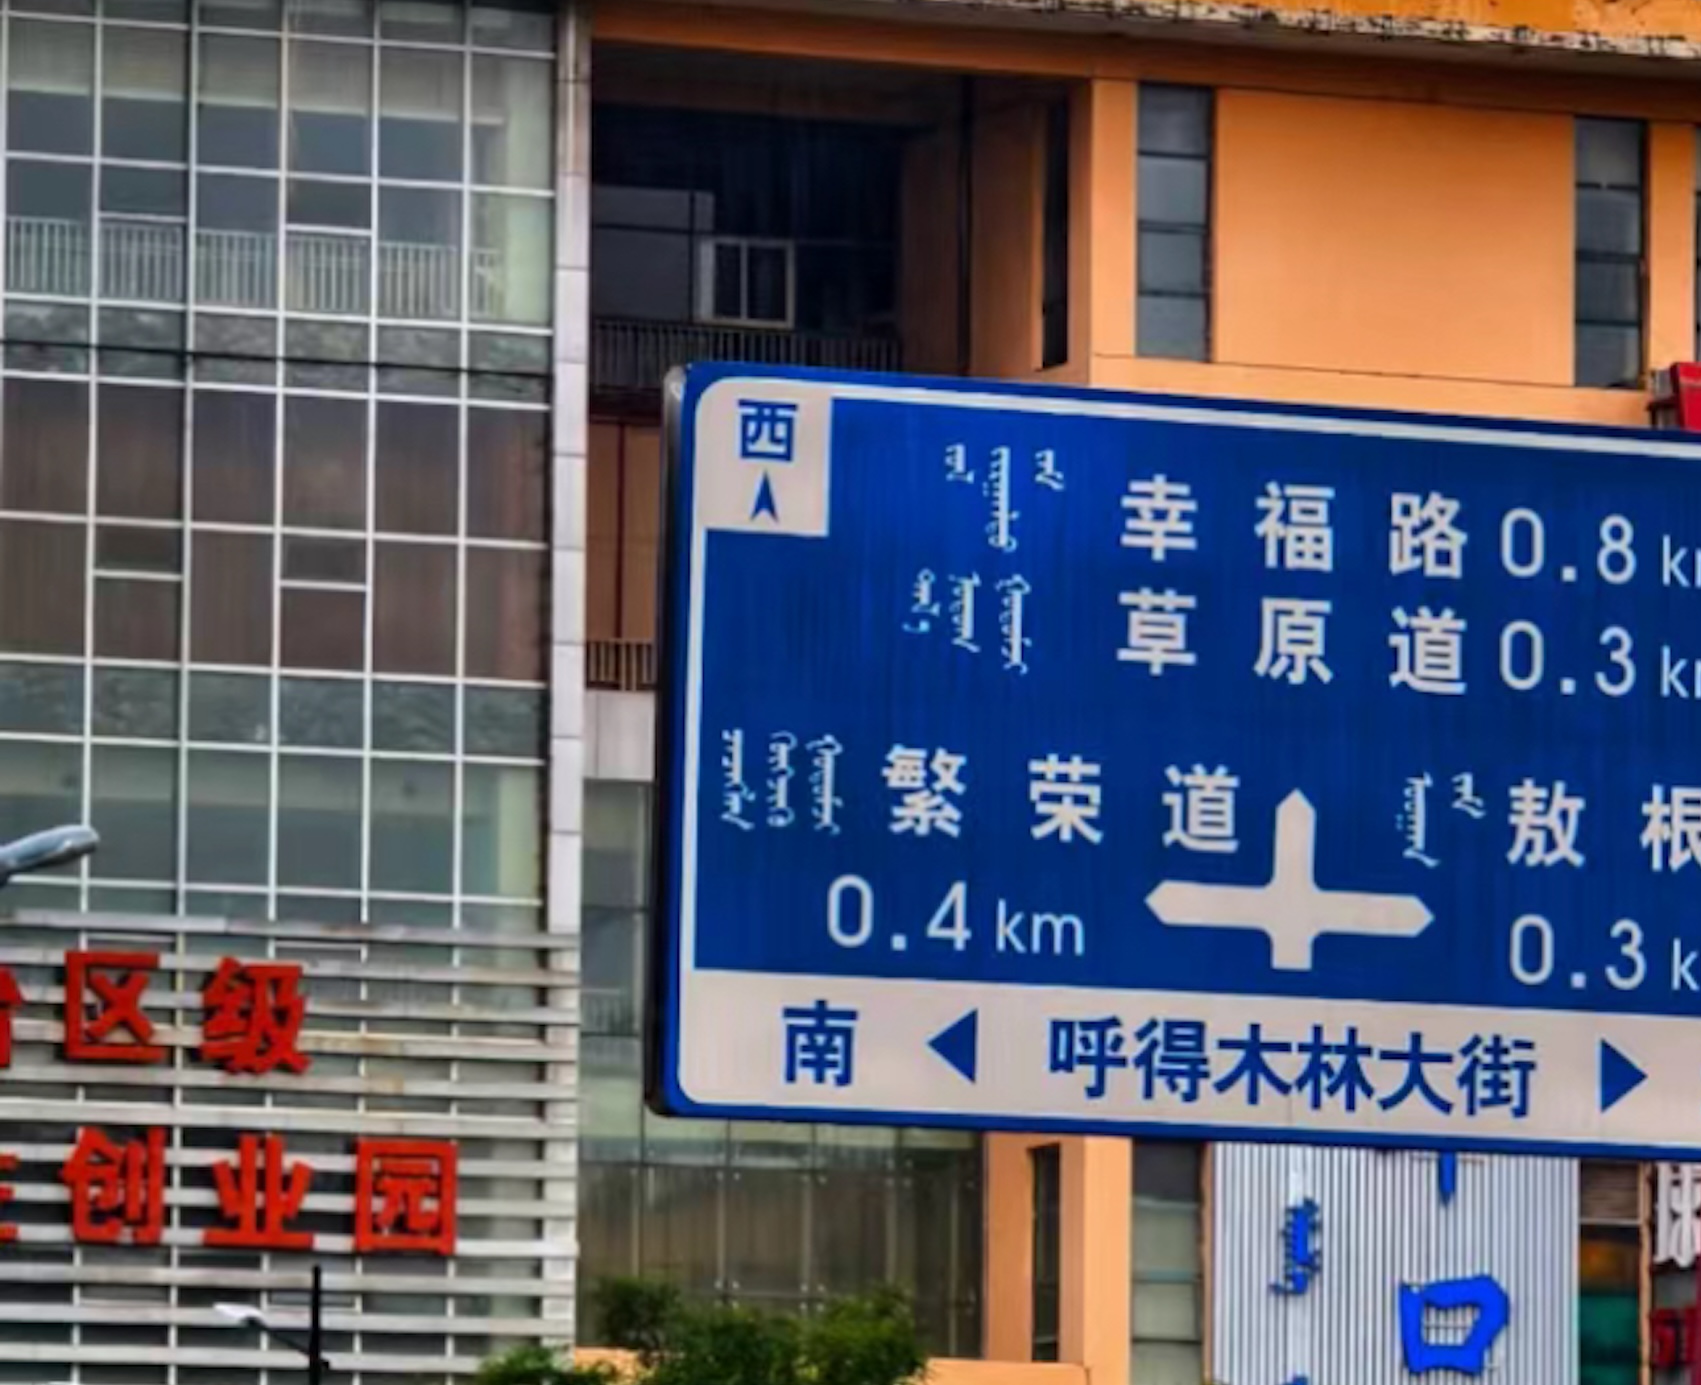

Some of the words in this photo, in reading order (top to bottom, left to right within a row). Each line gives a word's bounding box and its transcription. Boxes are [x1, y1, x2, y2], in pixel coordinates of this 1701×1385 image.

[738, 399, 797, 462] 西
[1120, 474, 1468, 579] 幸福路
[1117, 588, 1467, 695] 草原道
[882, 745, 1240, 855] 繁荣道
[996, 900, 1085, 955] km
[782, 998, 859, 1089] 南
[1047, 1015, 1537, 1120] 呼得木林大街
